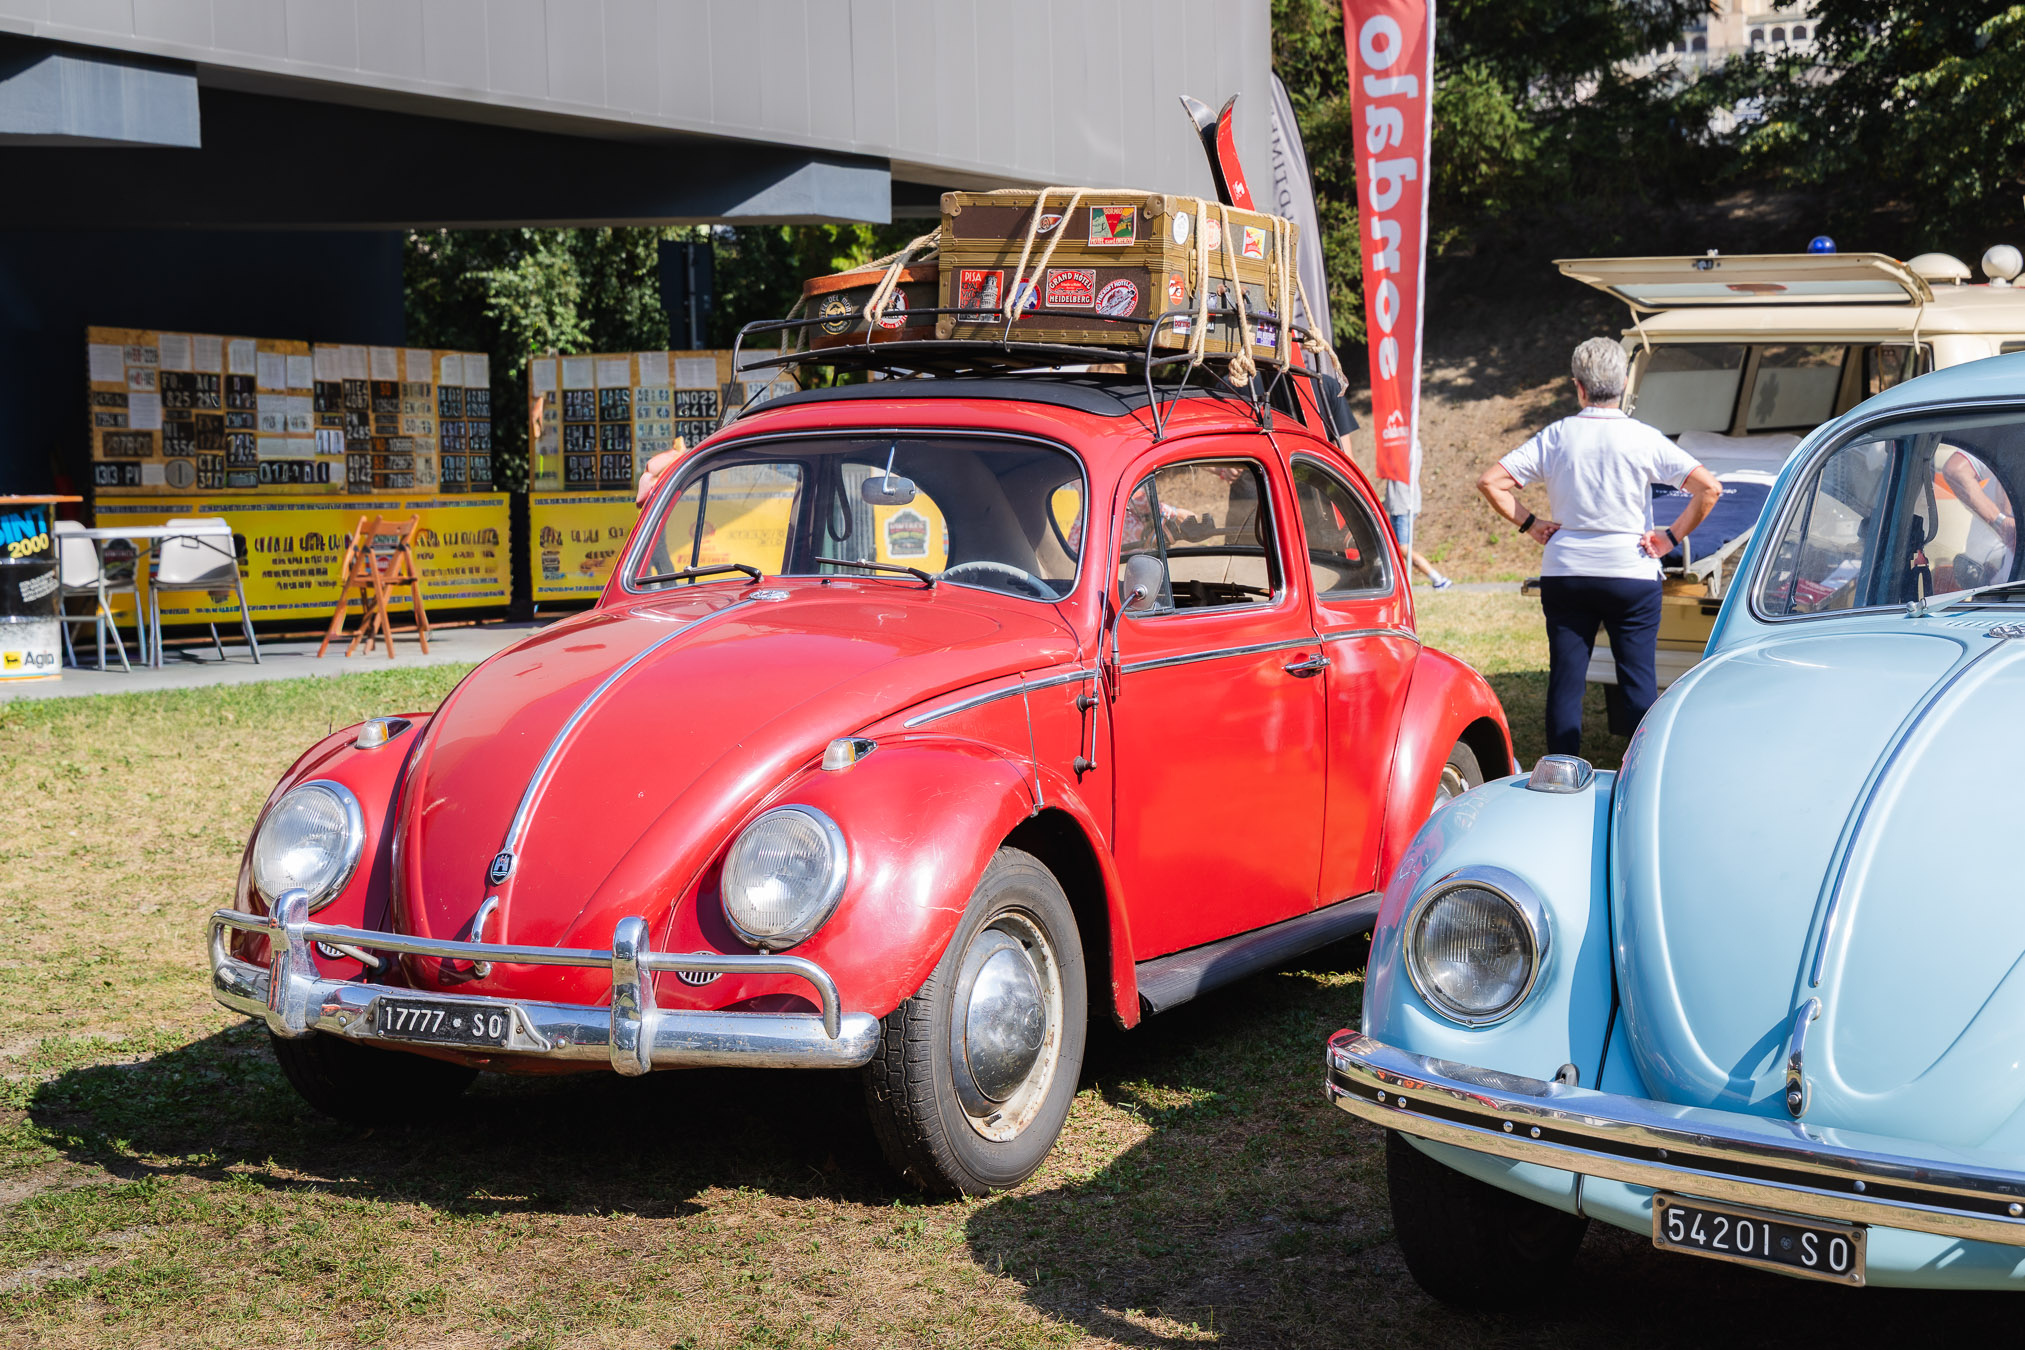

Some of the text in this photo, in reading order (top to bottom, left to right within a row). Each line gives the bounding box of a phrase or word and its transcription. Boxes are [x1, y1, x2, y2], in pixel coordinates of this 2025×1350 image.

[965, 272, 982, 282] PISA
[1049, 272, 1073, 289] GRAND
[1049, 295, 1091, 304] HEIDELBERG
[1174, 320, 1191, 329] bormio
[166, 391, 193, 408] 825
[0, 505, 47, 547] INT
[8, 533, 49, 558] 2000
[385, 1006, 502, 1039] 17777 SO
[1668, 1208, 1848, 1271] 54201 SO
